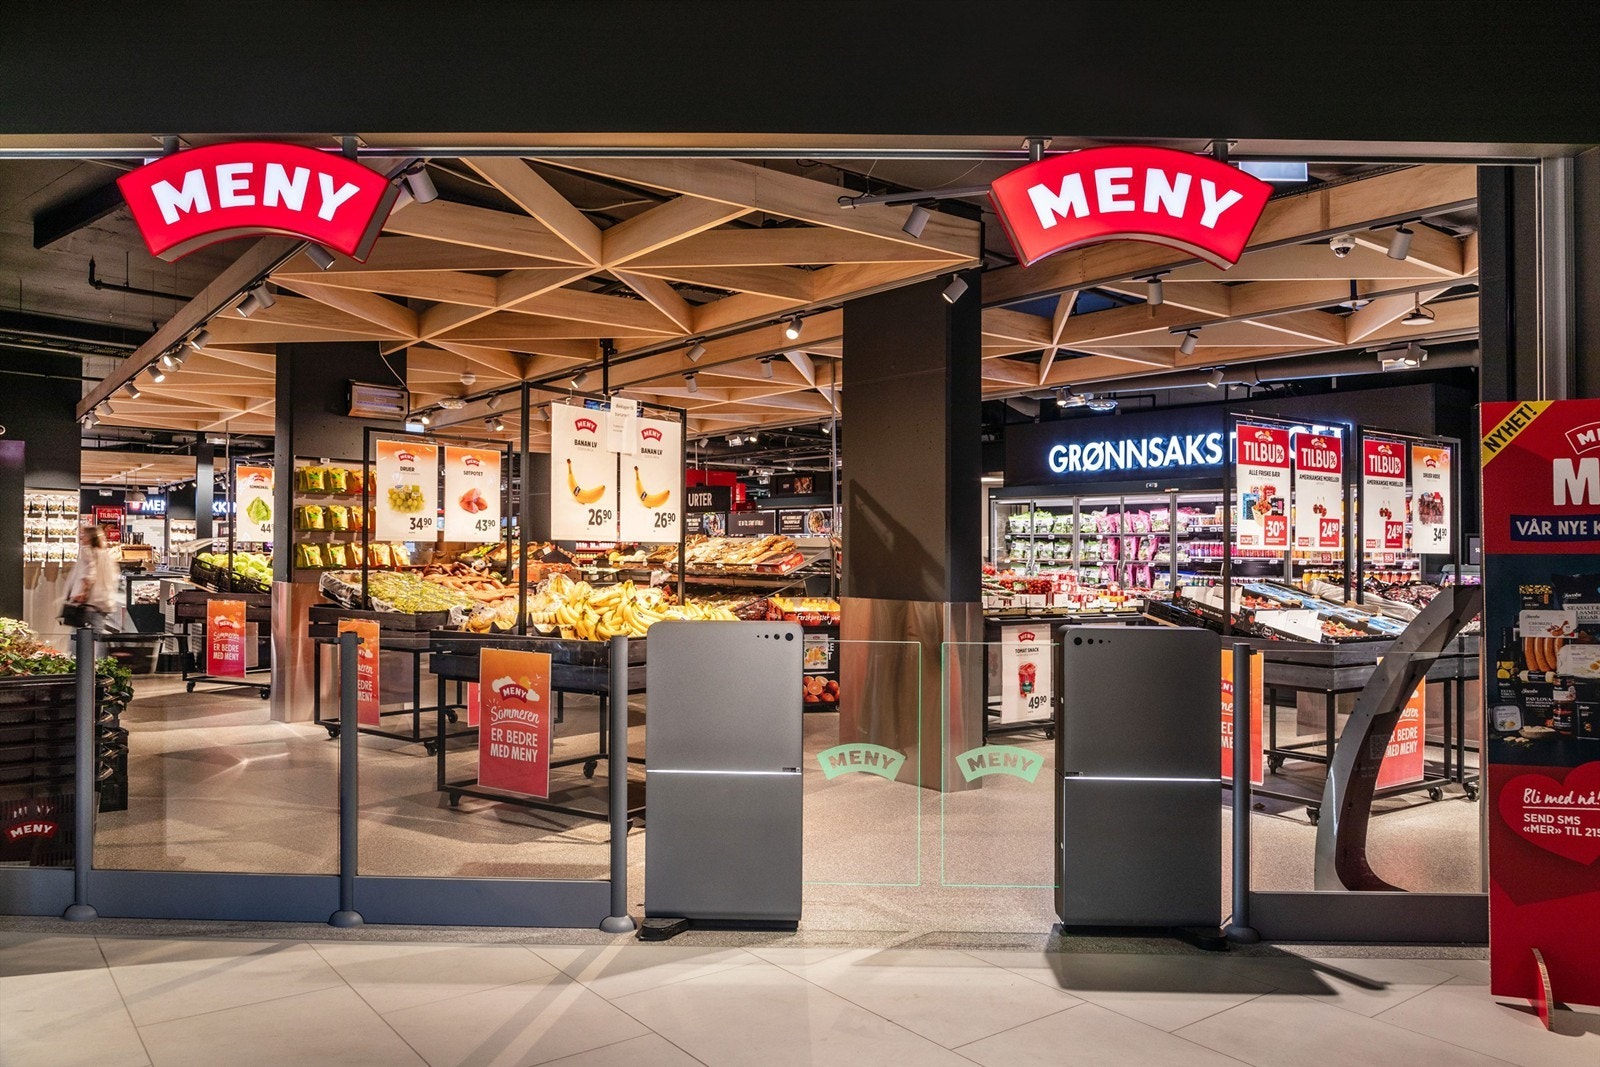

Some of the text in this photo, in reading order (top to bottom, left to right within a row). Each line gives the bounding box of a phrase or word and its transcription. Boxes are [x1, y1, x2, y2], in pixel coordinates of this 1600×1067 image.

[151, 162, 360, 225] MENY
[1027, 167, 1243, 229] MENY
[577, 420, 597, 431] MENY
[1483, 403, 1538, 453] NYHET!
[643, 430, 662, 440] MENY
[574, 439, 598, 449] BANAN LV
[641, 447, 657, 455] BANAN
[1243, 441, 1285, 464] TILBUD
[1301, 448, 1337, 469] TILBUD
[1369, 455, 1402, 475] TILBUD
[688, 492, 713, 507] URTER
[1516, 518, 1553, 536] VÅR
[1558, 520, 1588, 536] NYE
[213, 643, 240, 653] ER BEDRE
[213, 652, 240, 661] MED MENY
[358, 680, 373, 691] EDRE
[502, 687, 526, 699] MENY
[490, 706, 540, 724] Sommeren
[491, 728, 538, 747] ER BEDRE
[1397, 726, 1418, 740] BEDRE
[490, 743, 538, 763] MED MENY
[1400, 740, 1418, 755] MENY
[828, 750, 896, 770] MENY
[966, 752, 1035, 773] MENY
[1523, 788, 1542, 804] Bli
[1544, 790, 1575, 805] med
[1523, 813, 1581, 825] SEND SMS
[10, 824, 53, 838] MENY
[1523, 825, 1562, 835] «MER»
[1565, 826, 1582, 836] TIL
